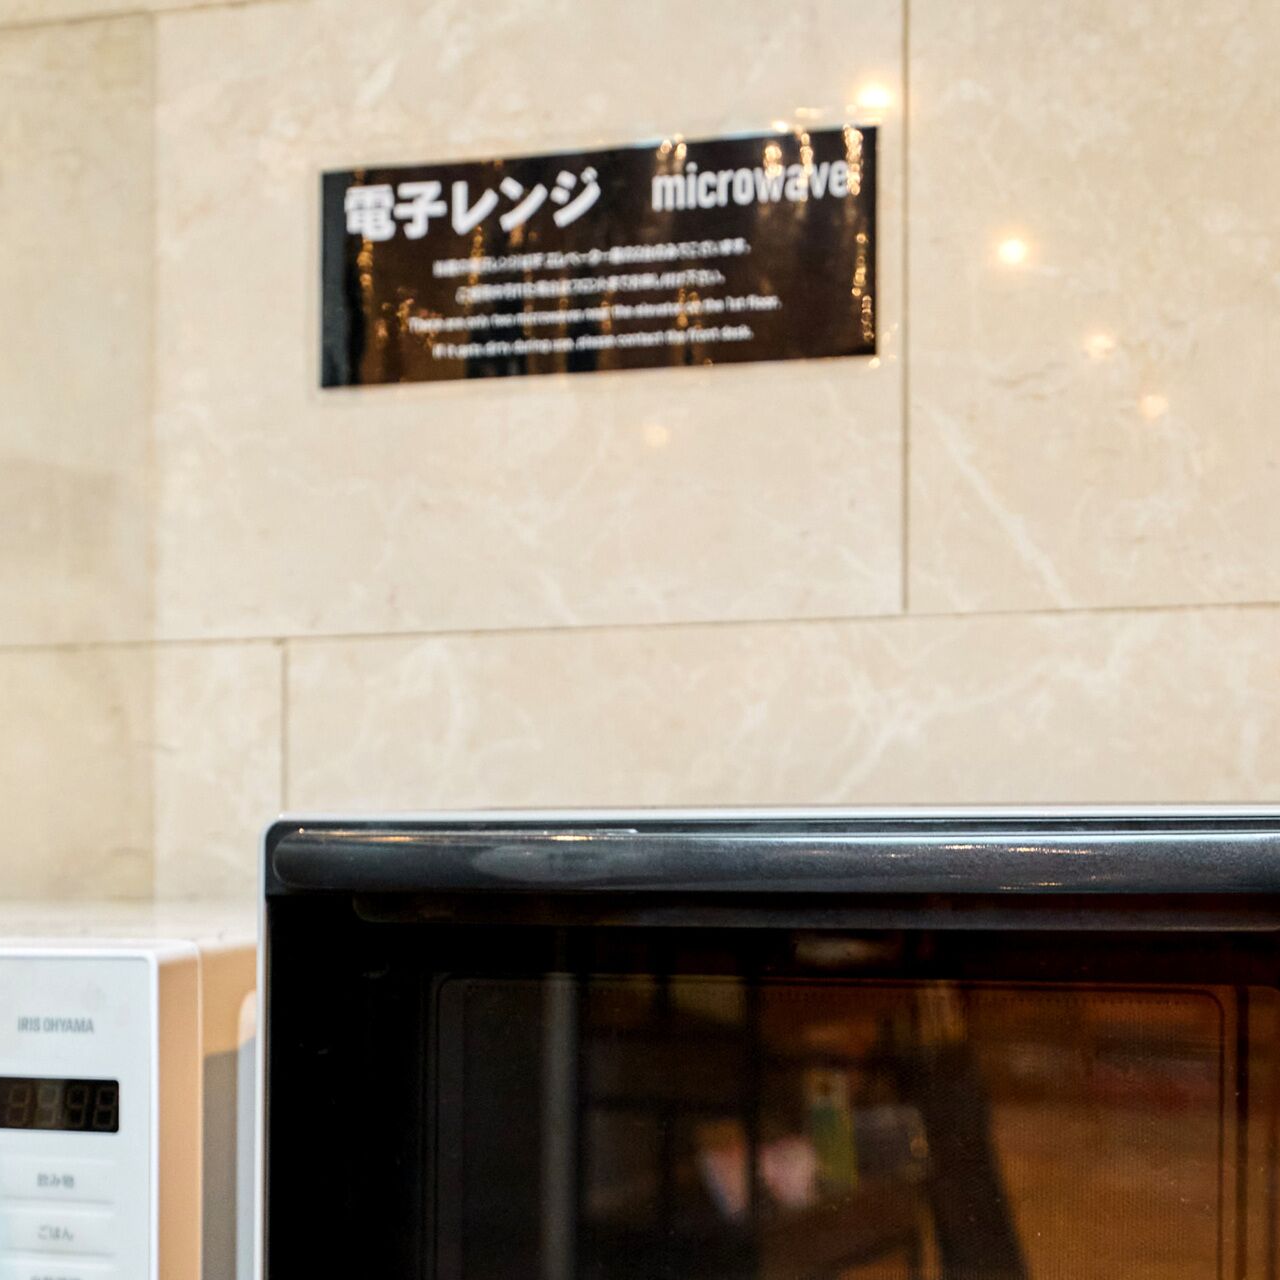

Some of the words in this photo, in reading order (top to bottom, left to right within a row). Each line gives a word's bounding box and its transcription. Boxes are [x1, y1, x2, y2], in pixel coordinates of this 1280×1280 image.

[651, 160, 848, 212] microwave
[344, 166, 601, 242] 電子レンジ
[17, 1016, 41, 1033] IRIS
[43, 1017, 95, 1034] OHYAMA
[37, 1224, 75, 1242] ごはん
